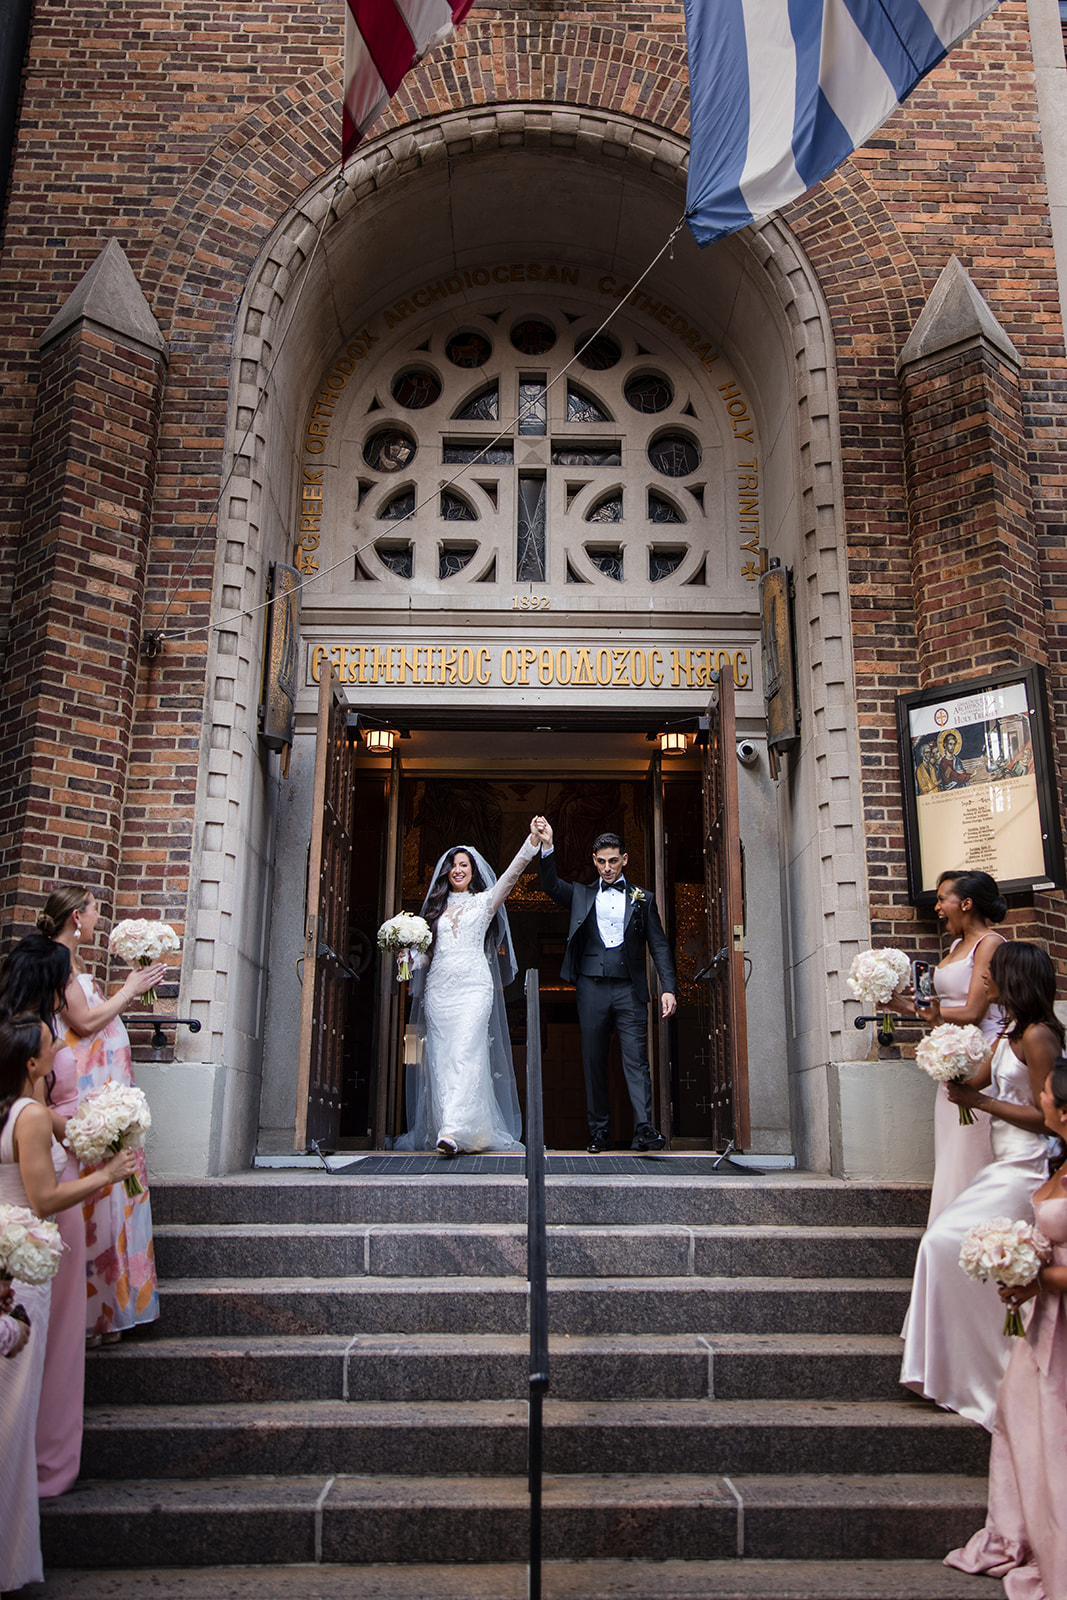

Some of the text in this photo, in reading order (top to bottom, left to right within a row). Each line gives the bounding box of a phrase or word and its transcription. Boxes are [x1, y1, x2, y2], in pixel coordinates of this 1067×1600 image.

[299, 263, 761, 555] GREEK ORTHODOX ARCHDIOCESAN CATHEDRAL HOLY TRINITY
[512, 595, 551, 609] 1892
